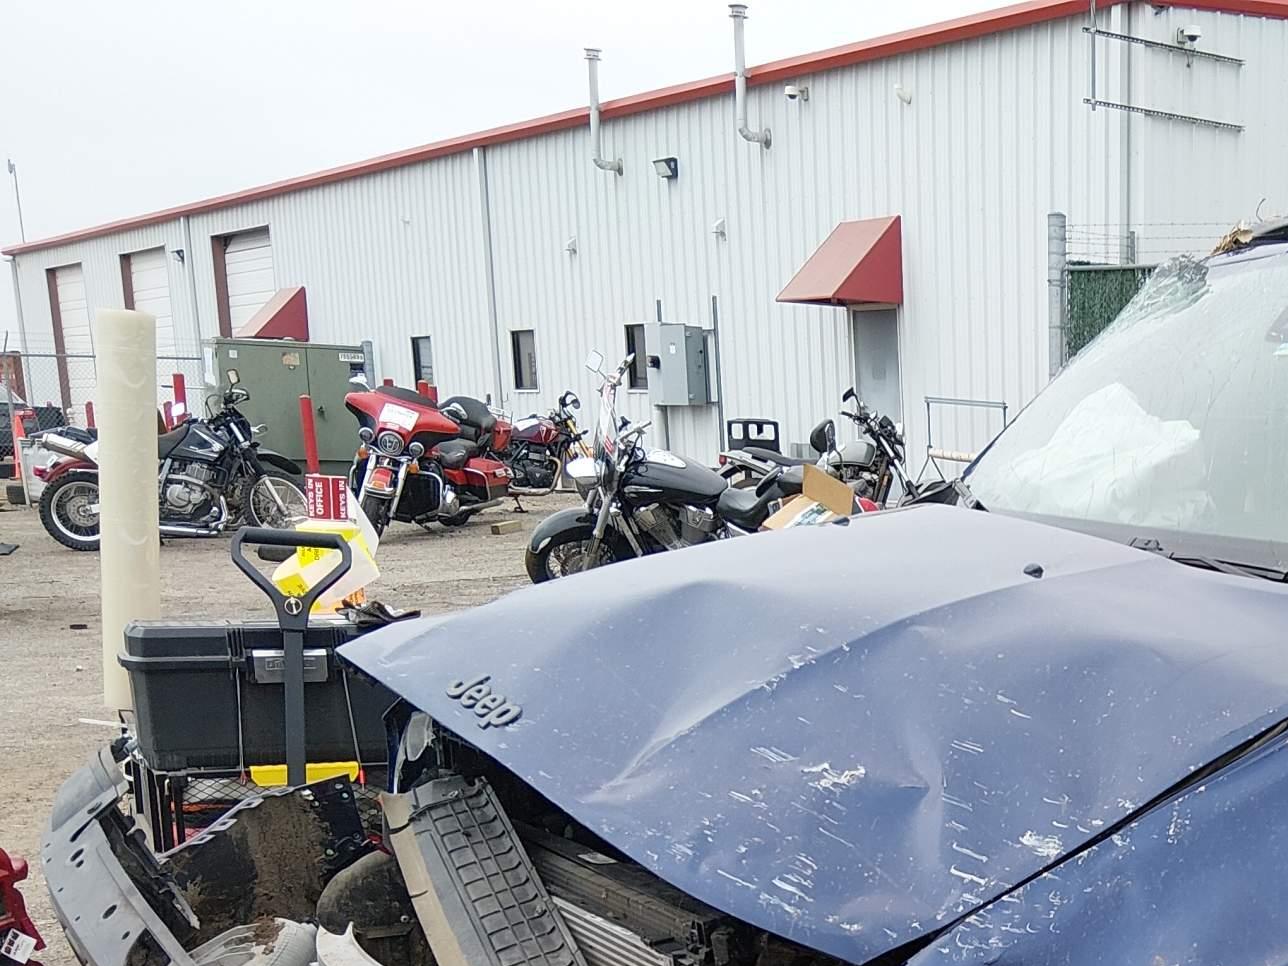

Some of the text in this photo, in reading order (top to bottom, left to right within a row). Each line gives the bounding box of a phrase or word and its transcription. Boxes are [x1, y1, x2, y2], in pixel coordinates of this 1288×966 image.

[308, 479, 314, 489] IN
[315, 481, 325, 516] OFFICE
[338, 480, 347, 519] KEYS IN
[446, 673, 523, 730] Jeep
